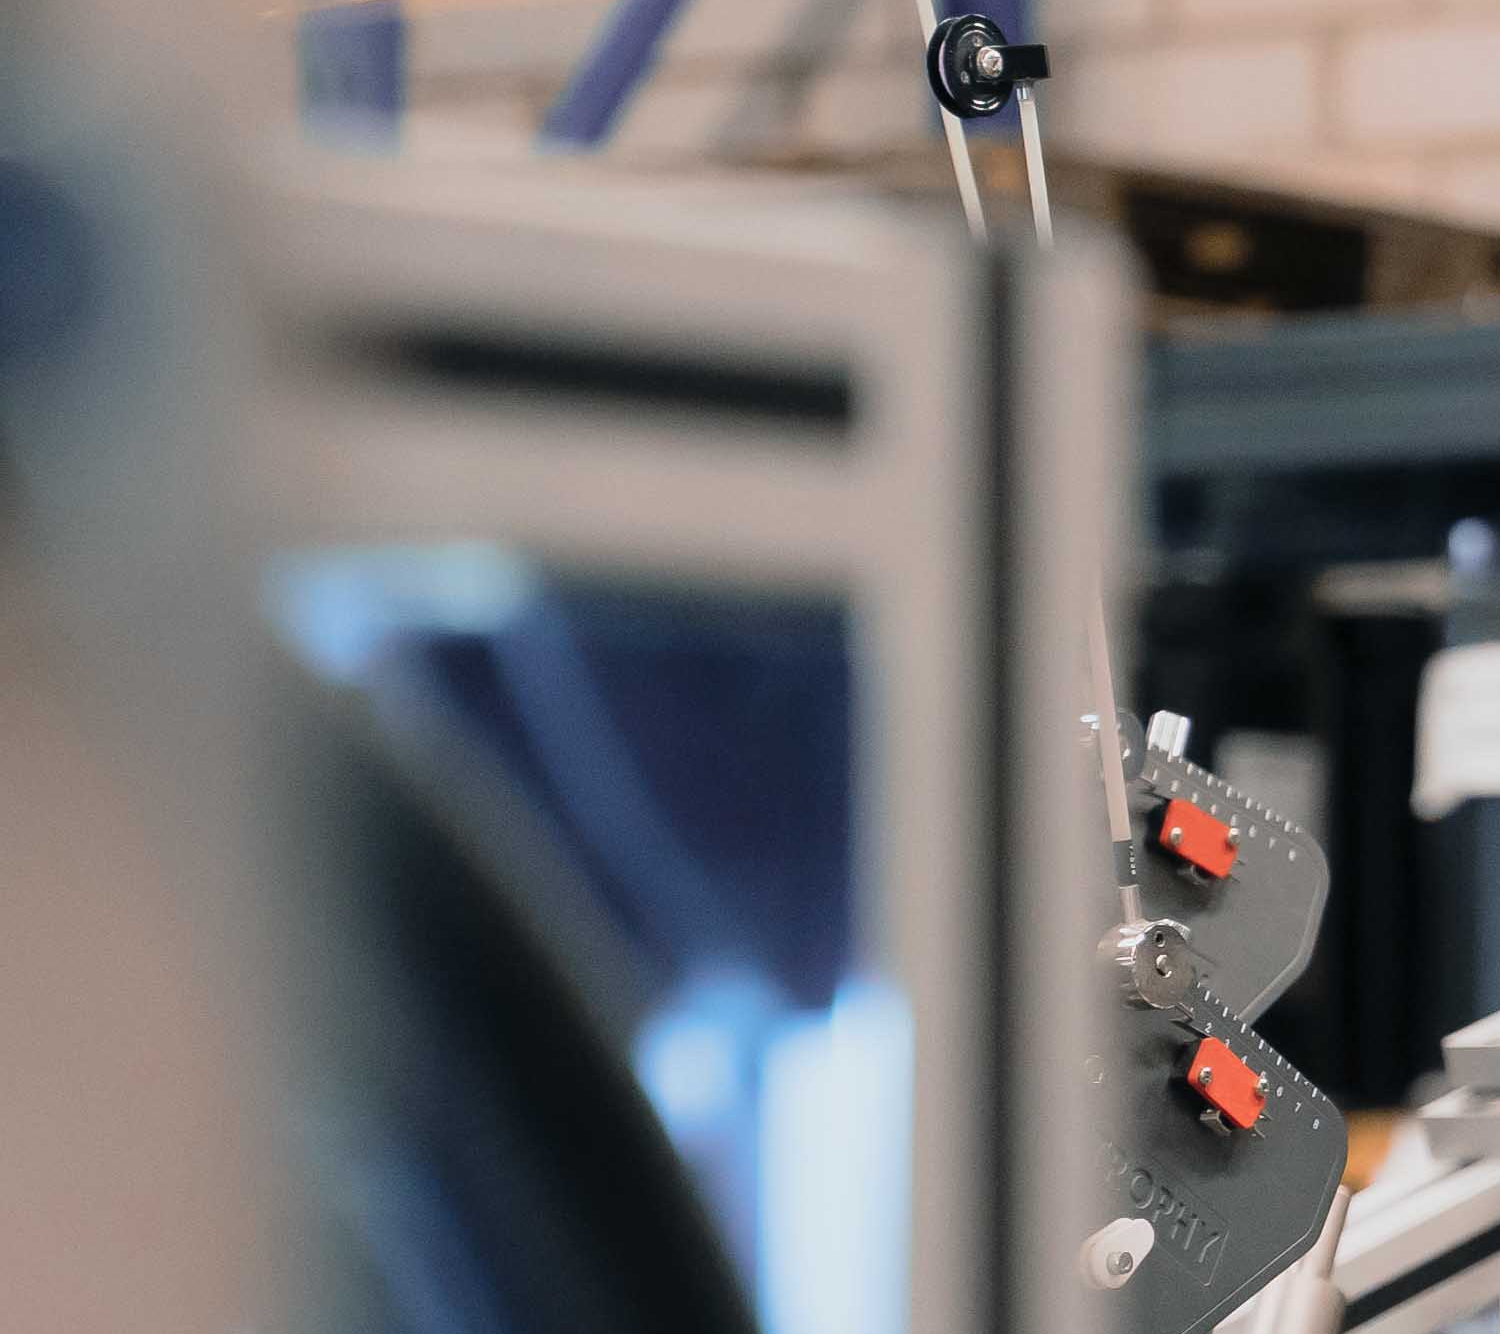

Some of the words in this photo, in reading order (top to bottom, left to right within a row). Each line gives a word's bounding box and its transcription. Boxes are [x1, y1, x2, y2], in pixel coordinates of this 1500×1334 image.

[1204, 1022, 1212, 1034] 2
[1276, 1086, 1284, 1098] 6
[1294, 1101, 1302, 1113] 7
[1312, 1118, 1320, 1130] 8
[1095, 1137, 1221, 1264] ROPHY
